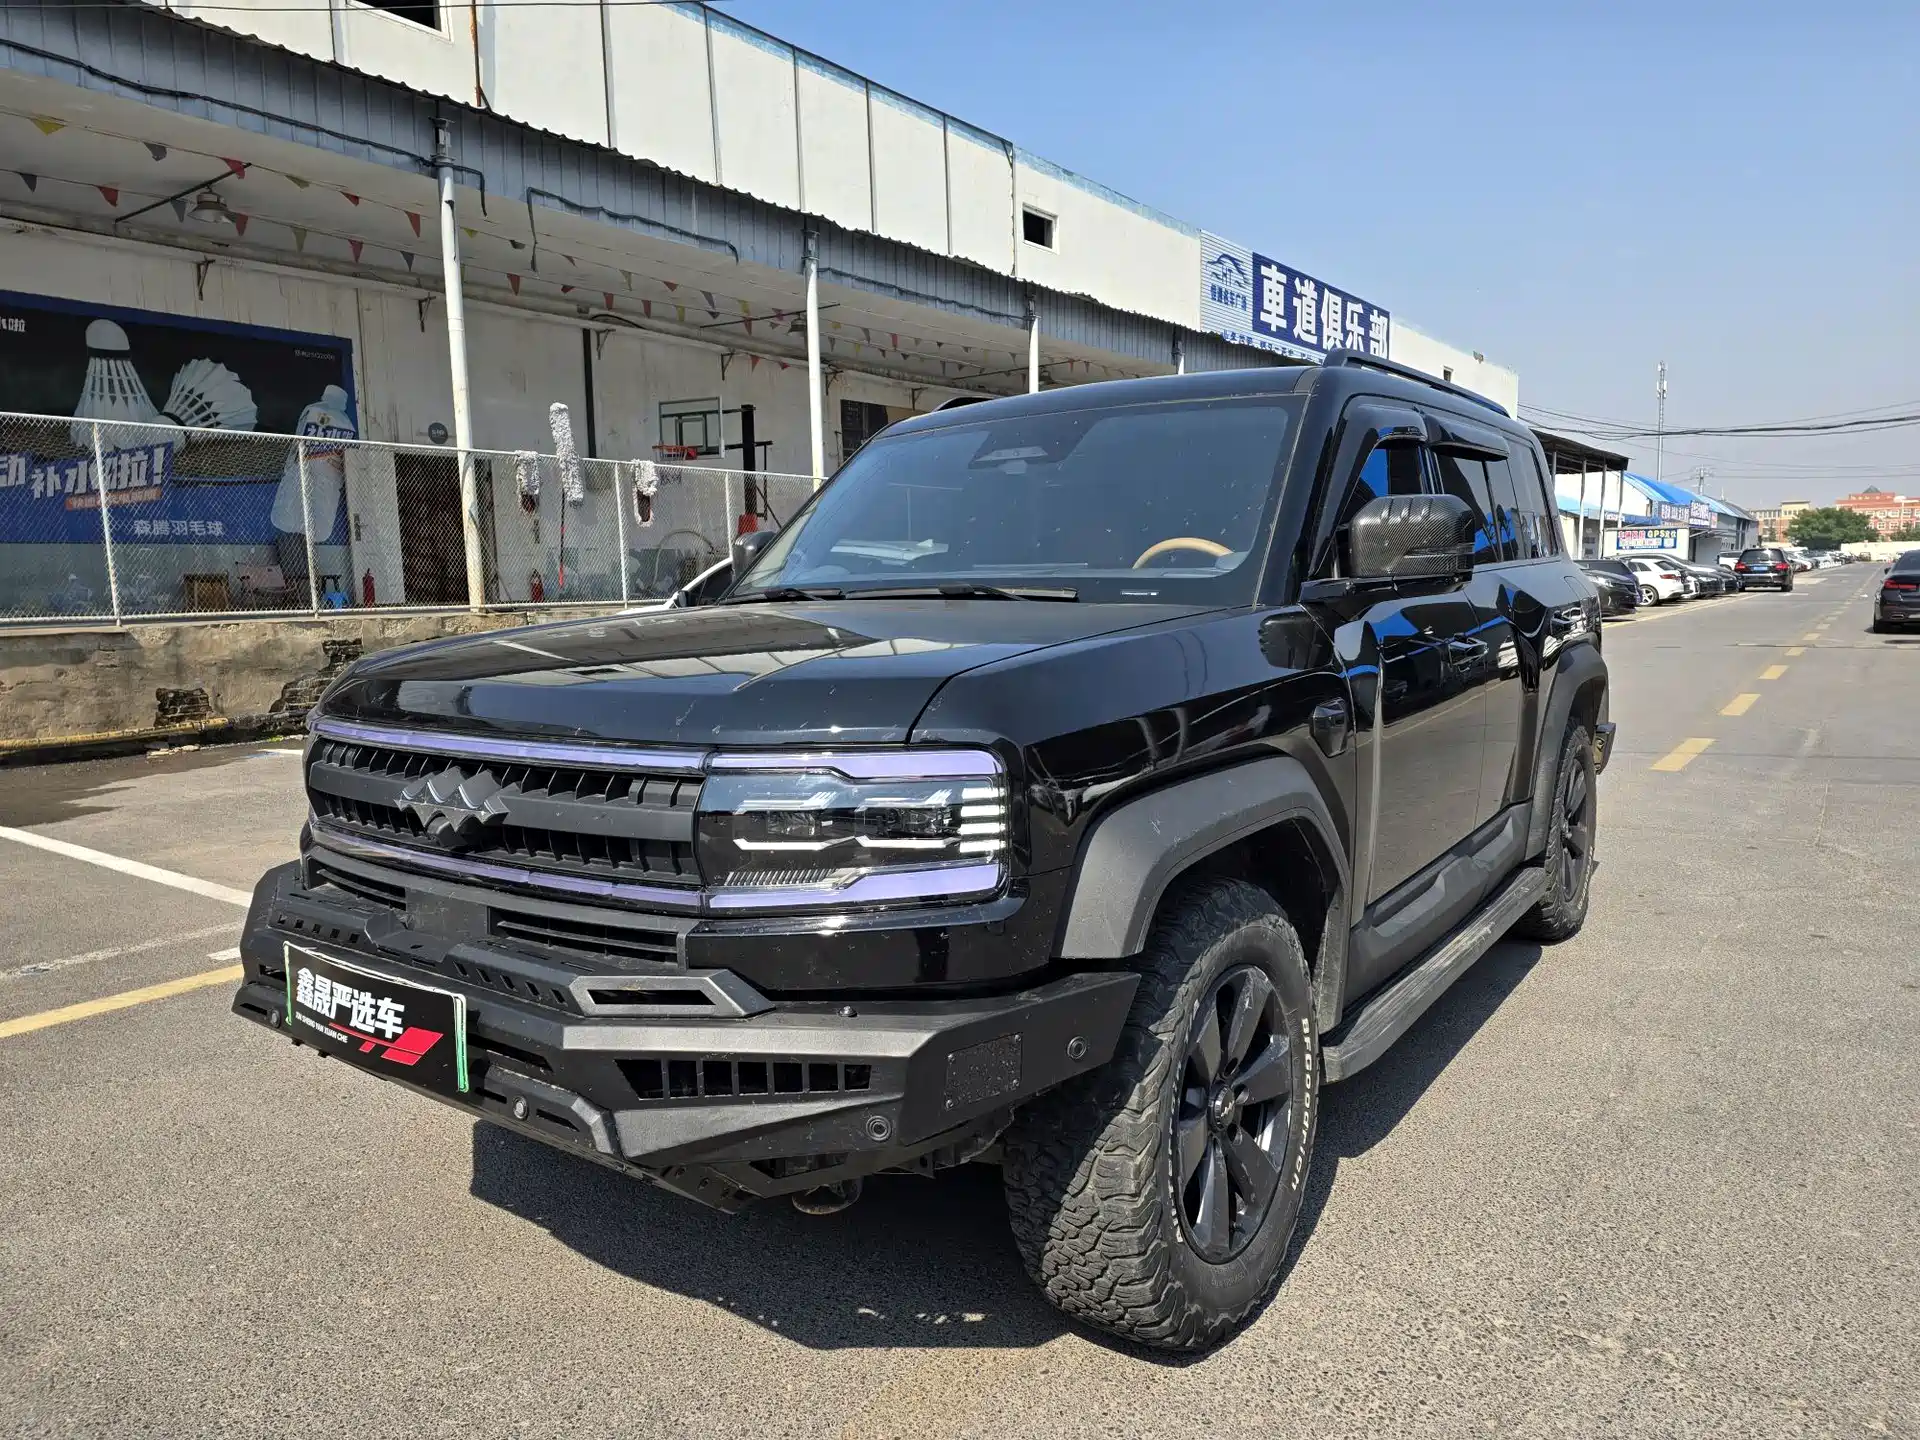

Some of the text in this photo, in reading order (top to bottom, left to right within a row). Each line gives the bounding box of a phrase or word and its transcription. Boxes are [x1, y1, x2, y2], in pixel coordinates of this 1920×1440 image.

[1260, 264, 1388, 359] 車道俱乐部
[296, 967, 405, 1039] 鑫晟严选车
[336, 1033, 348, 1043] CHE
